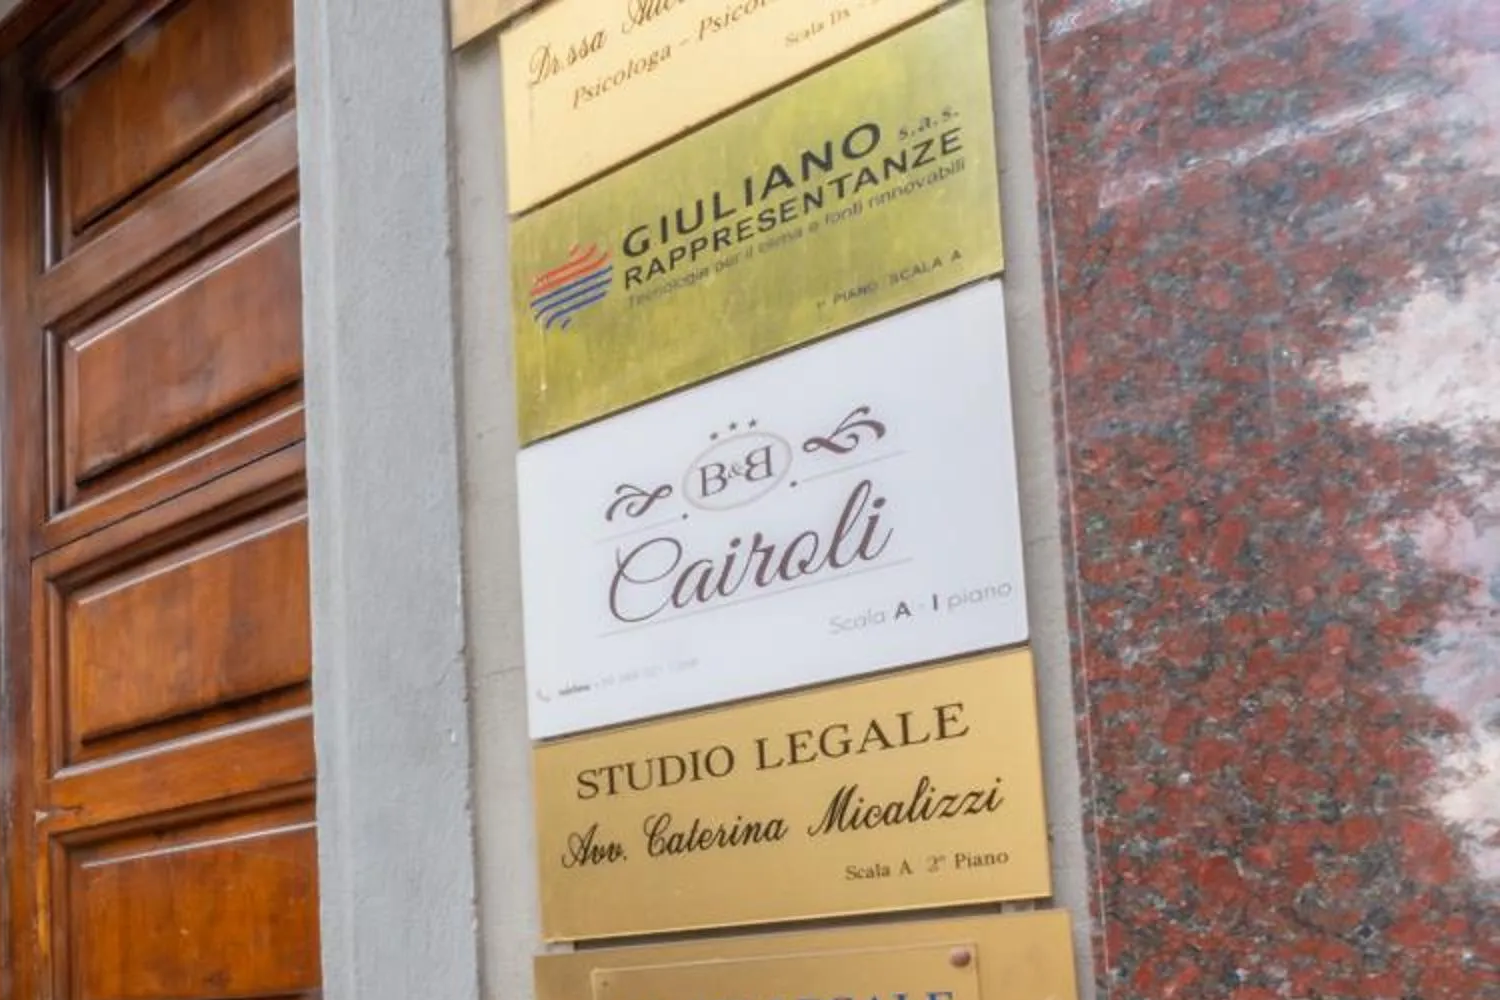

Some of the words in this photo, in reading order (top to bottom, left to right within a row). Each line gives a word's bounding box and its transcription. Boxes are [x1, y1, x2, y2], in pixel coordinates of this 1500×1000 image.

[572, 45, 673, 109] Psicologa
[622, 122, 881, 258] GIULIANO
[625, 127, 964, 291] RAPPRESENTANZE
[868, 157, 965, 209] rinnovabili
[889, 256, 943, 285] SCALA
[951, 249, 962, 263] A
[608, 479, 895, 623] Cairoli
[828, 608, 886, 635] Scala
[895, 601, 912, 621] A
[947, 581, 1013, 612] piano
[576, 745, 735, 801] STUDIO
[755, 702, 971, 771] LEGALE
[561, 822, 628, 869] Avv.
[643, 812, 788, 858] Caterina
[807, 775, 1006, 837] Micalizzi
[844, 863, 892, 882] Scala
[899, 858, 914, 876] A
[953, 851, 1010, 870] Piano
